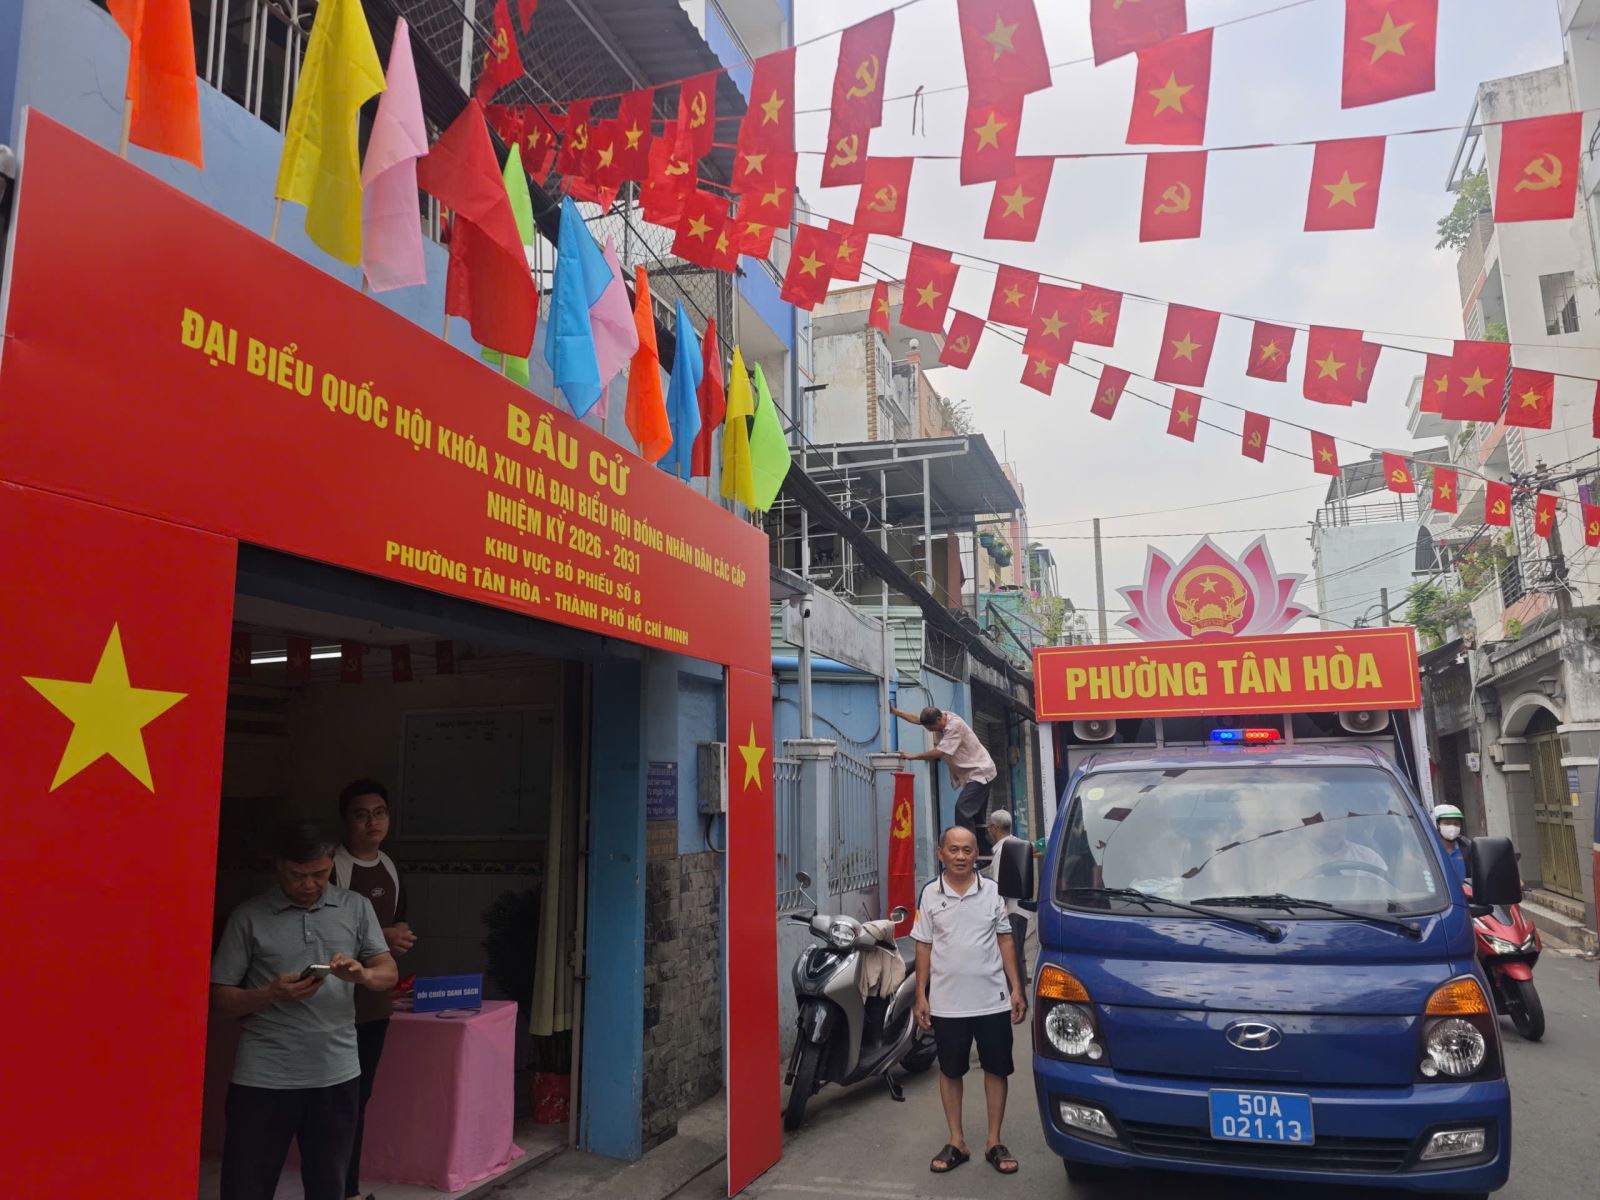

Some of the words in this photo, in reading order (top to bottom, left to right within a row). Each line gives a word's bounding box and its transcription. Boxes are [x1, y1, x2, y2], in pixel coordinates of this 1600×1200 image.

[181, 308, 238, 366] ĐẠI
[247, 337, 313, 396] BIỂU
[322, 373, 389, 429] QUỐC
[395, 405, 432, 451] HỘI
[438, 426, 489, 475] KHÓA
[494, 452, 521, 489] XVI
[526, 467, 546, 500] VÀ
[550, 479, 575, 514] ĐẠI
[578, 491, 608, 527] BIỂU
[611, 509, 631, 540] HỘI
[666, 535, 693, 565] NHÂN
[695, 547, 714, 574] DÂN
[714, 557, 730, 582] CÁC
[731, 563, 746, 588] CẤP
[507, 403, 578, 470] BẦU
[589, 450, 631, 496] CỬ
[485, 536, 518, 564] KHU
[523, 549, 551, 575] VỰC
[555, 560, 573, 582] BỎ
[577, 568, 613, 595] PHIẾU
[616, 583, 631, 602] SỐ
[634, 590, 641, 605] 8
[487, 490, 542, 536] NHIỆM
[546, 514, 566, 545] KỲ
[569, 525, 602, 559] 2026
[613, 544, 640, 575] 2031
[386, 540, 467, 583] PHƯỜNG
[472, 566, 505, 593] TÂN
[510, 578, 541, 604] HÒA
[555, 592, 598, 620] THÀNH
[601, 606, 625, 628] PHỐ
[645, 620, 662, 638] CHÍ
[664, 625, 689, 645] MINH
[1065, 655, 1208, 701] PHƯỜNG
[1217, 651, 1292, 695] TÂN
[1302, 645, 1383, 691] HÒA
[1222, 1116, 1302, 1141] 021.13
[1238, 1094, 1281, 1117] 50A
